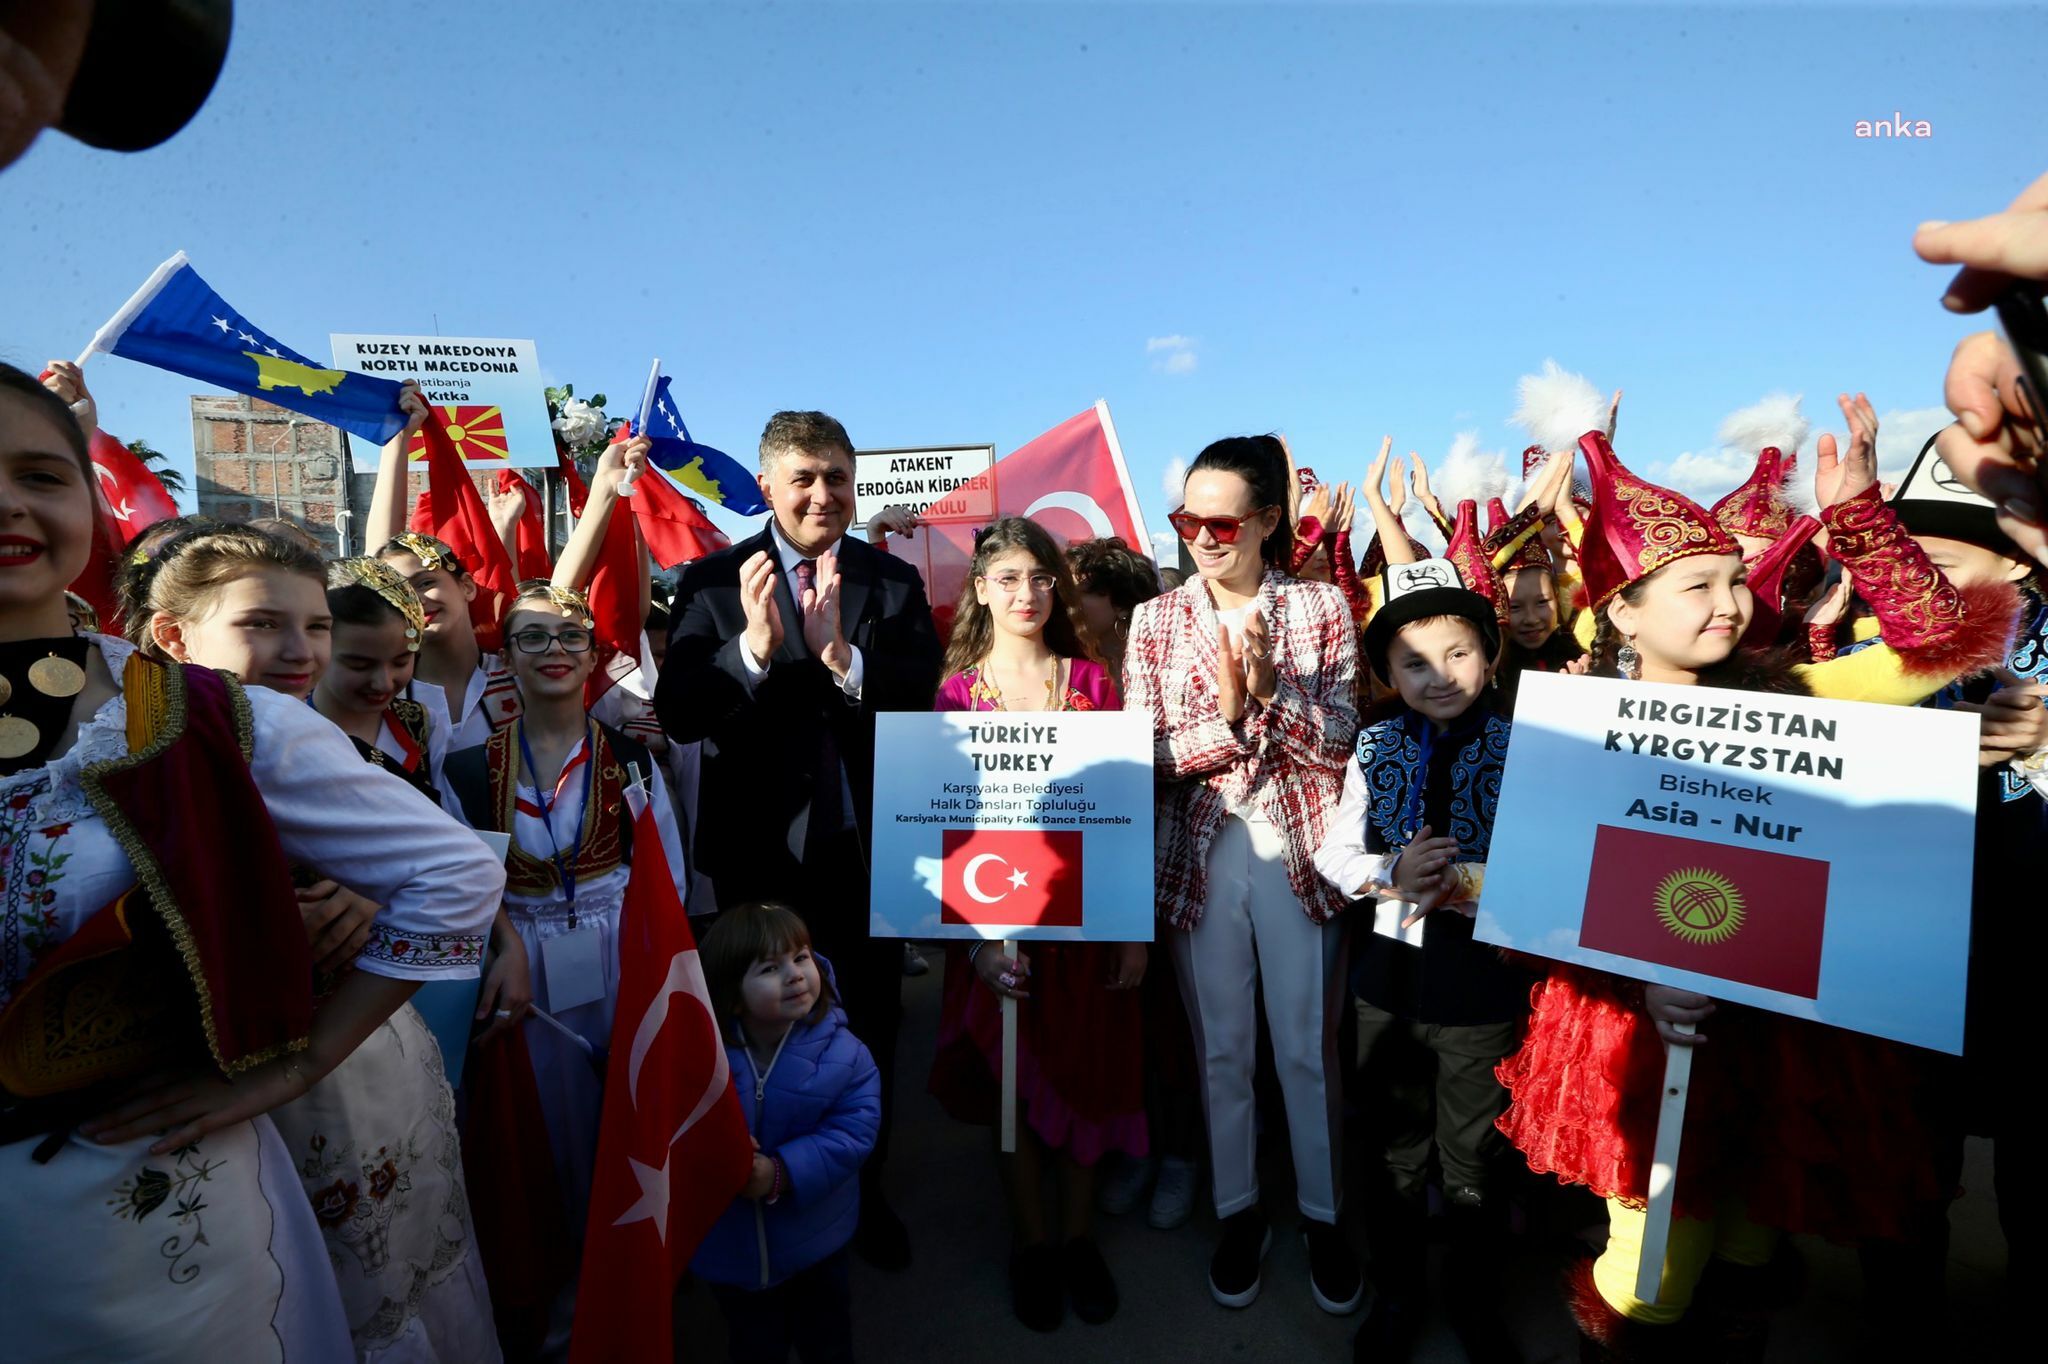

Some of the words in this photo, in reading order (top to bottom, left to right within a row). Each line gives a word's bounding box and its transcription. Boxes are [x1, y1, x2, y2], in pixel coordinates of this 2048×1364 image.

[356, 342, 412, 355] KUZEY
[418, 344, 517, 358] MAKEDONYA
[361, 359, 418, 372] NORTH
[424, 361, 520, 373] MACEDONIA
[890, 456, 953, 473] ATAKENT
[856, 477, 924, 497] ERDOĞAN
[928, 475, 989, 493] KİBARER
[883, 500, 967, 516] AOKULU
[1617, 697, 1837, 742] KIRGIZİSTAN
[968, 721, 1058, 744] TÜRKİYE
[971, 753, 1054, 772] TURKEY
[1603, 729, 1844, 780] KYRGYZSTAN
[943, 782, 1009, 796] Karşıyaka
[1012, 782, 1084, 796] Belediyesi
[1659, 773, 1774, 806] Bishkek
[930, 798, 962, 810] Halk
[965, 798, 1022, 811] Dansları
[1025, 799, 1096, 813] Topluluğu
[895, 813, 947, 825] Karsiyaka
[949, 814, 1014, 826] Municipality
[1016, 815, 1039, 824] Folk
[1042, 815, 1076, 825] Dance
[1078, 815, 1132, 825] Ensemble
[1625, 798, 1699, 828] Asia
[1733, 812, 1803, 843] Nur
